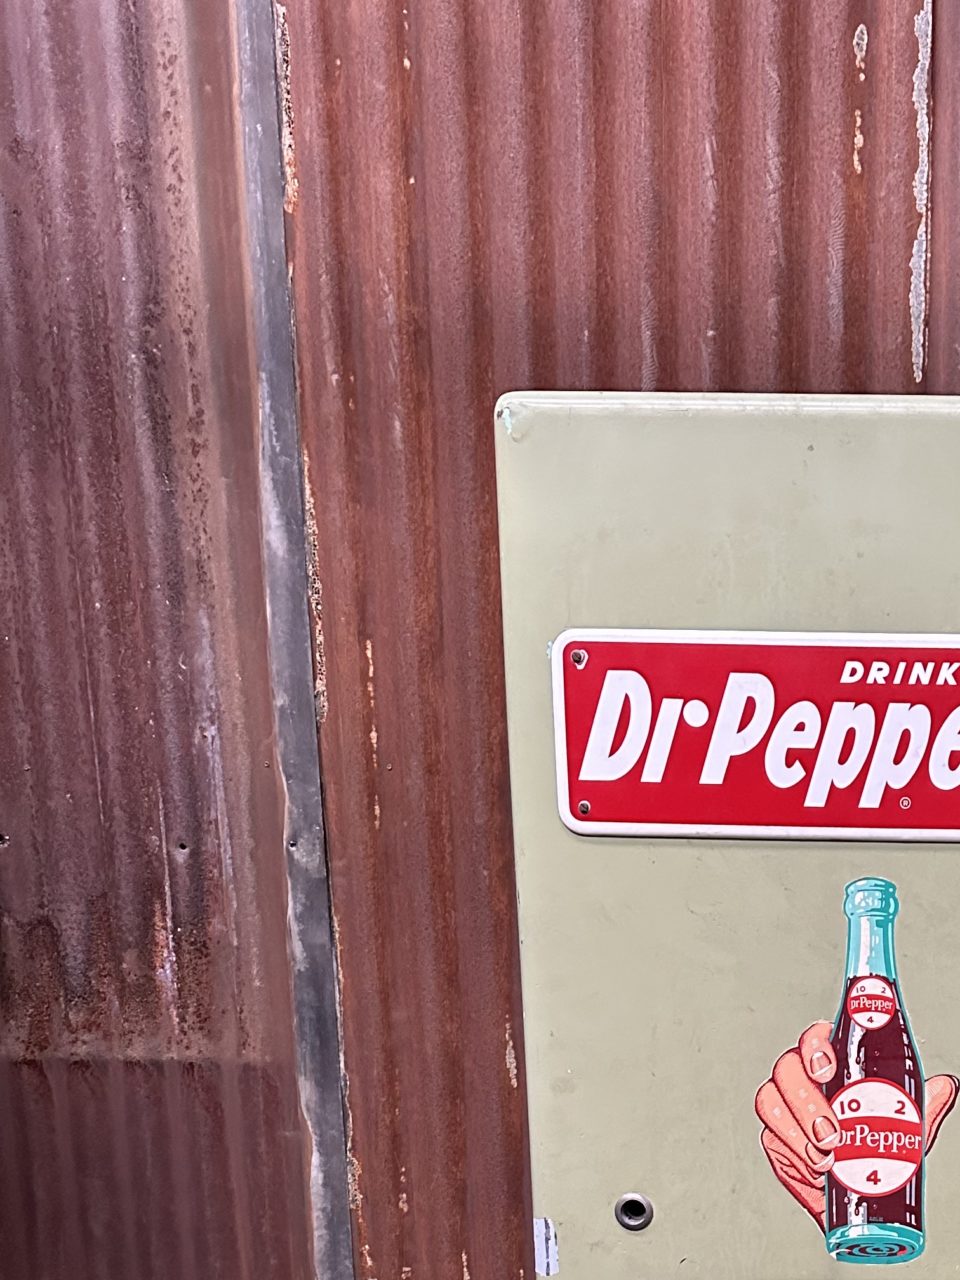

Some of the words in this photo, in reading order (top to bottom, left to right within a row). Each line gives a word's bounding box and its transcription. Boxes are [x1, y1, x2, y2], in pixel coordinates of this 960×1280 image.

[856, 985, 866, 994] 10
[881, 986, 887, 994] 2
[866, 1015, 875, 1024] 4
[839, 1098, 862, 1115] 10
[894, 1100, 906, 1116] 2
[866, 1169, 882, 1186] 4
